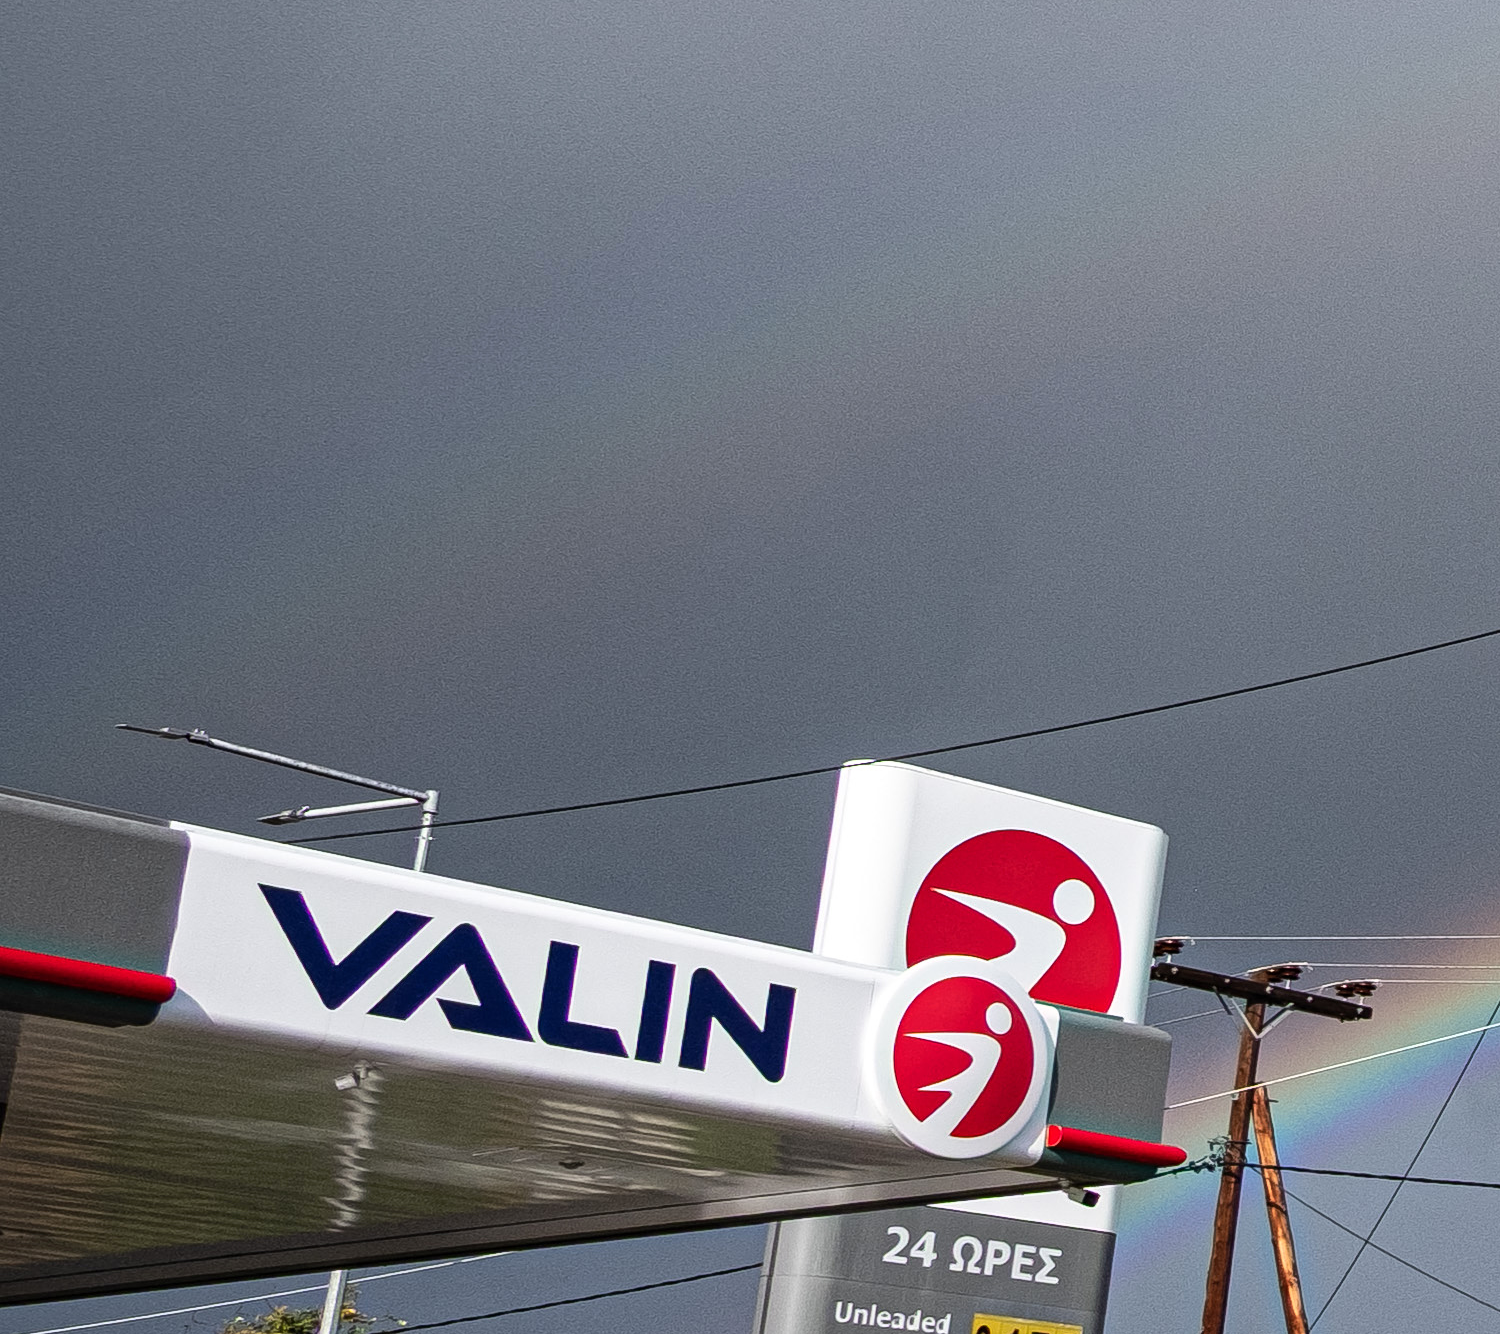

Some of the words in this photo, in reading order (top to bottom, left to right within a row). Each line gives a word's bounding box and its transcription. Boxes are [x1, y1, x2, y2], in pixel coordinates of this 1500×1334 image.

[257, 883, 797, 1084] VALIN
[882, 1225, 938, 1268] 24
[948, 1235, 1063, 1285] ΩΡΕΣ
[834, 1301, 952, 1334] Unleaded
